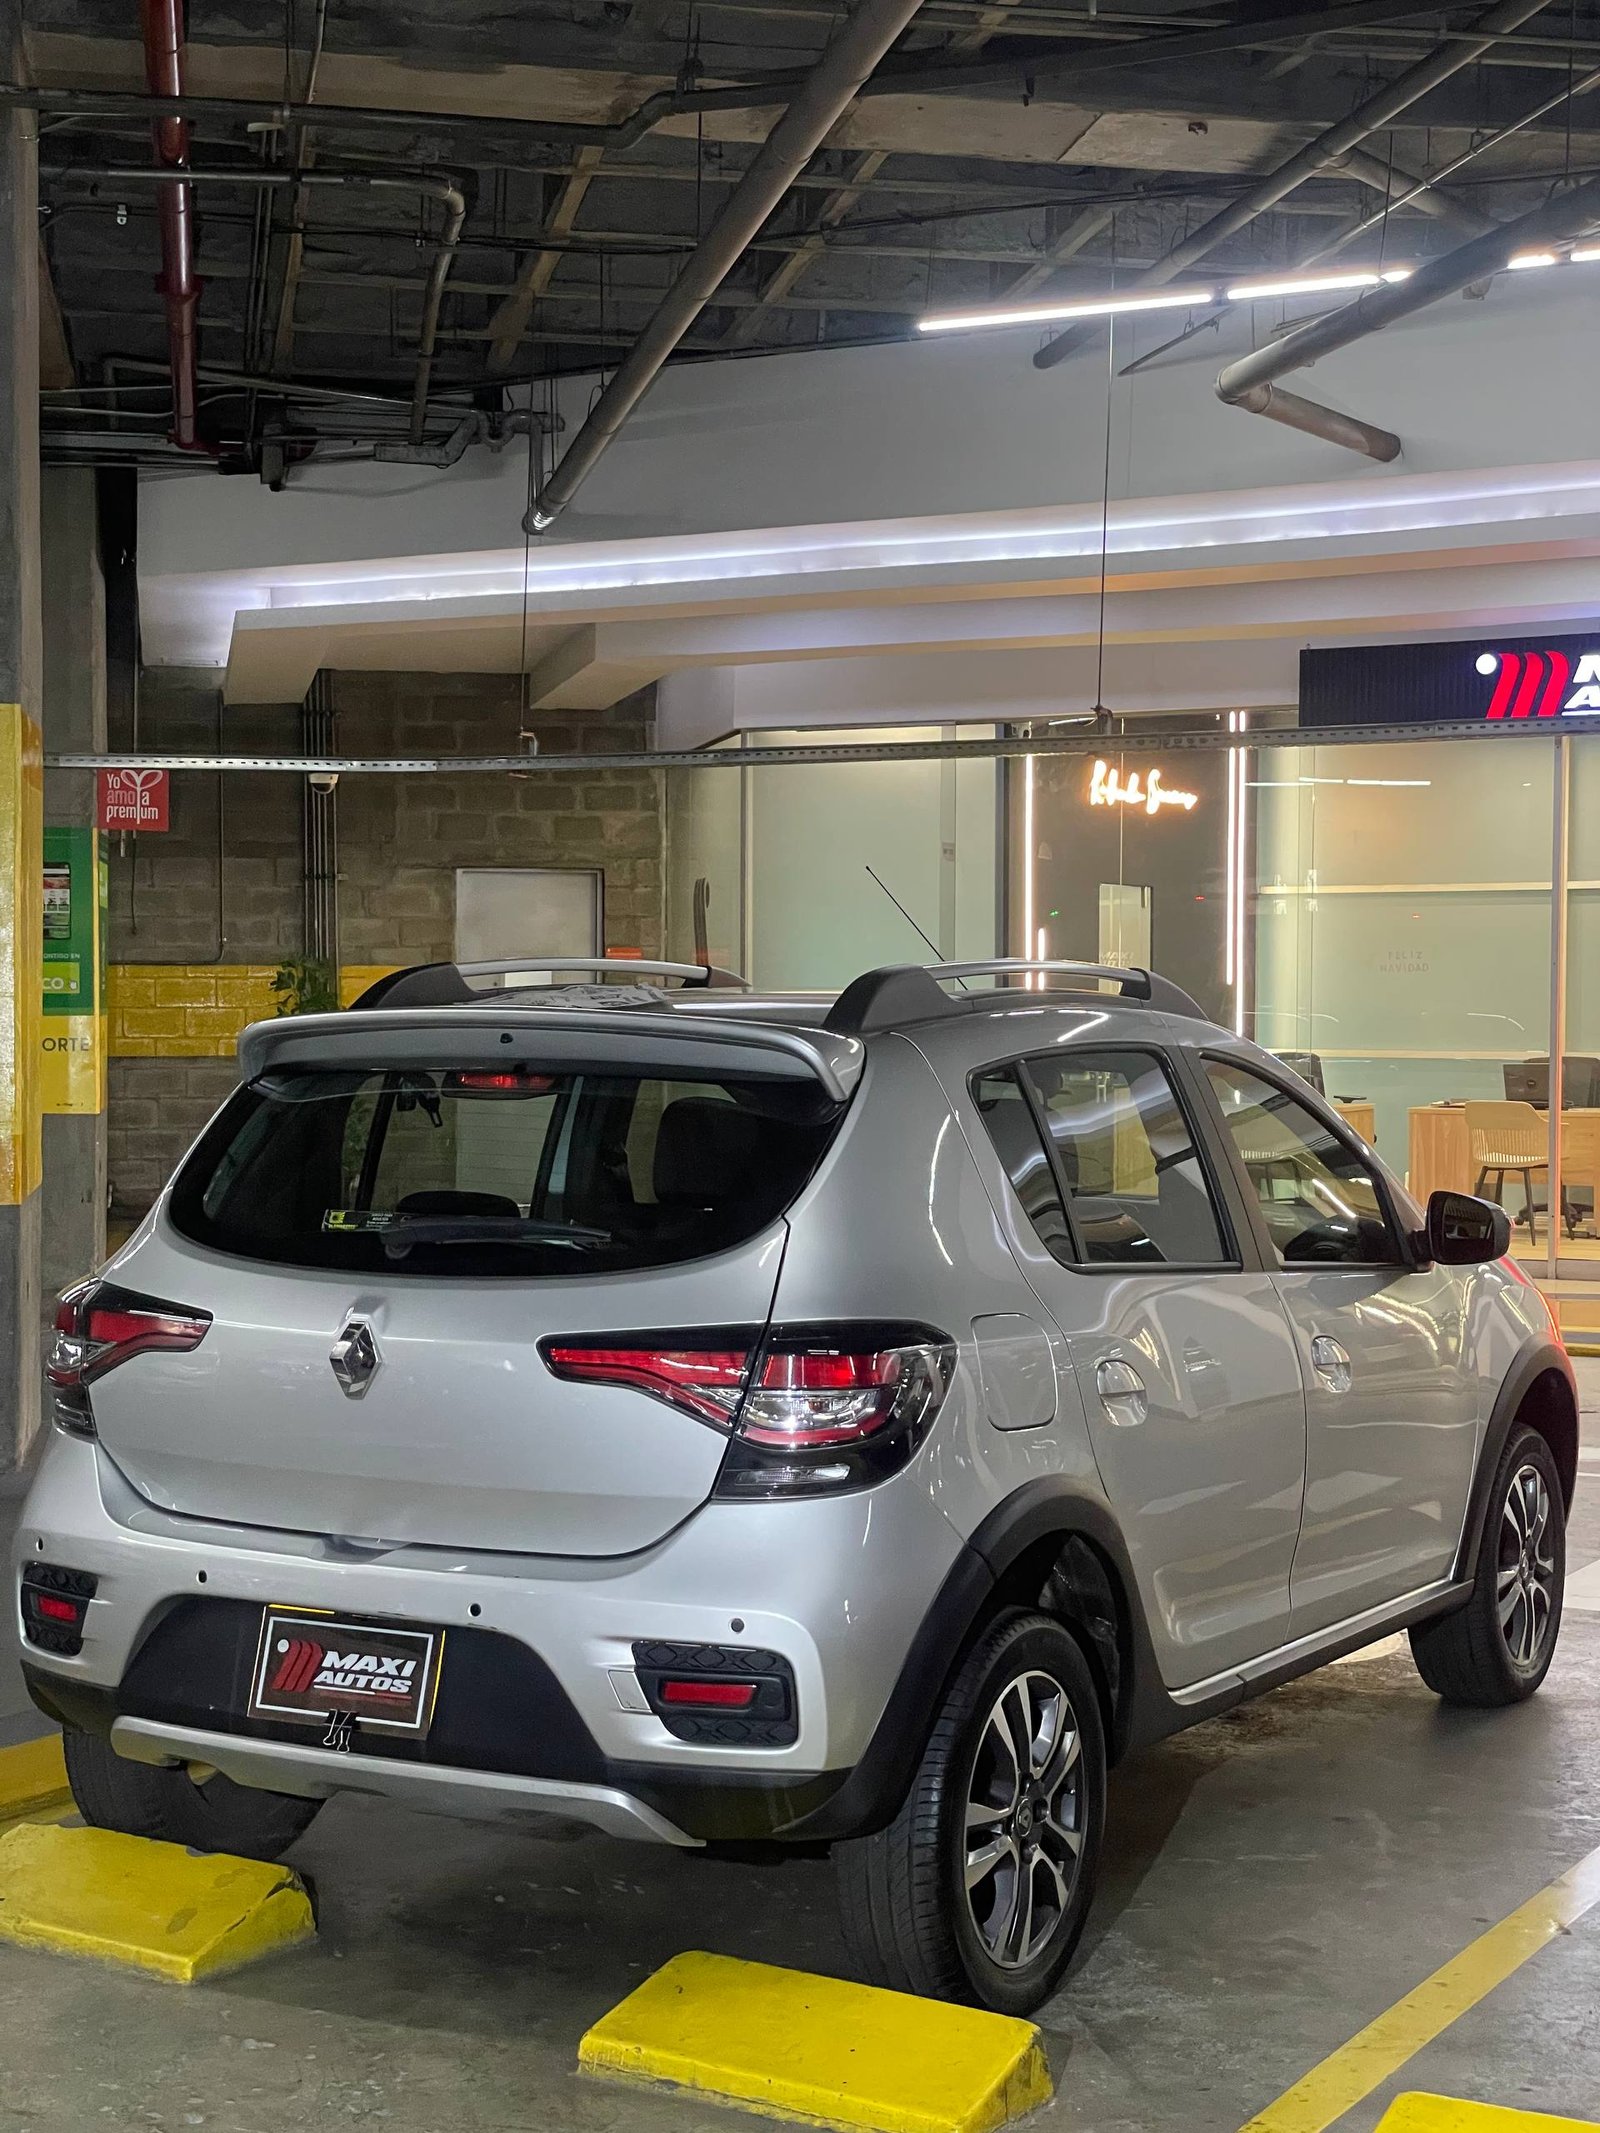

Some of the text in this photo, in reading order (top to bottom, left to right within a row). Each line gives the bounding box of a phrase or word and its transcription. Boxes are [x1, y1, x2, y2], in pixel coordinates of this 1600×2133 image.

[107, 773, 120, 789] Yo
[107, 789, 135, 805] amo
[1388, 951, 1424, 960] FELIZ
[1379, 962, 1430, 973] NAVIDAD
[321, 1650, 417, 1677] MAXI
[313, 1670, 412, 1693] AUTOS
